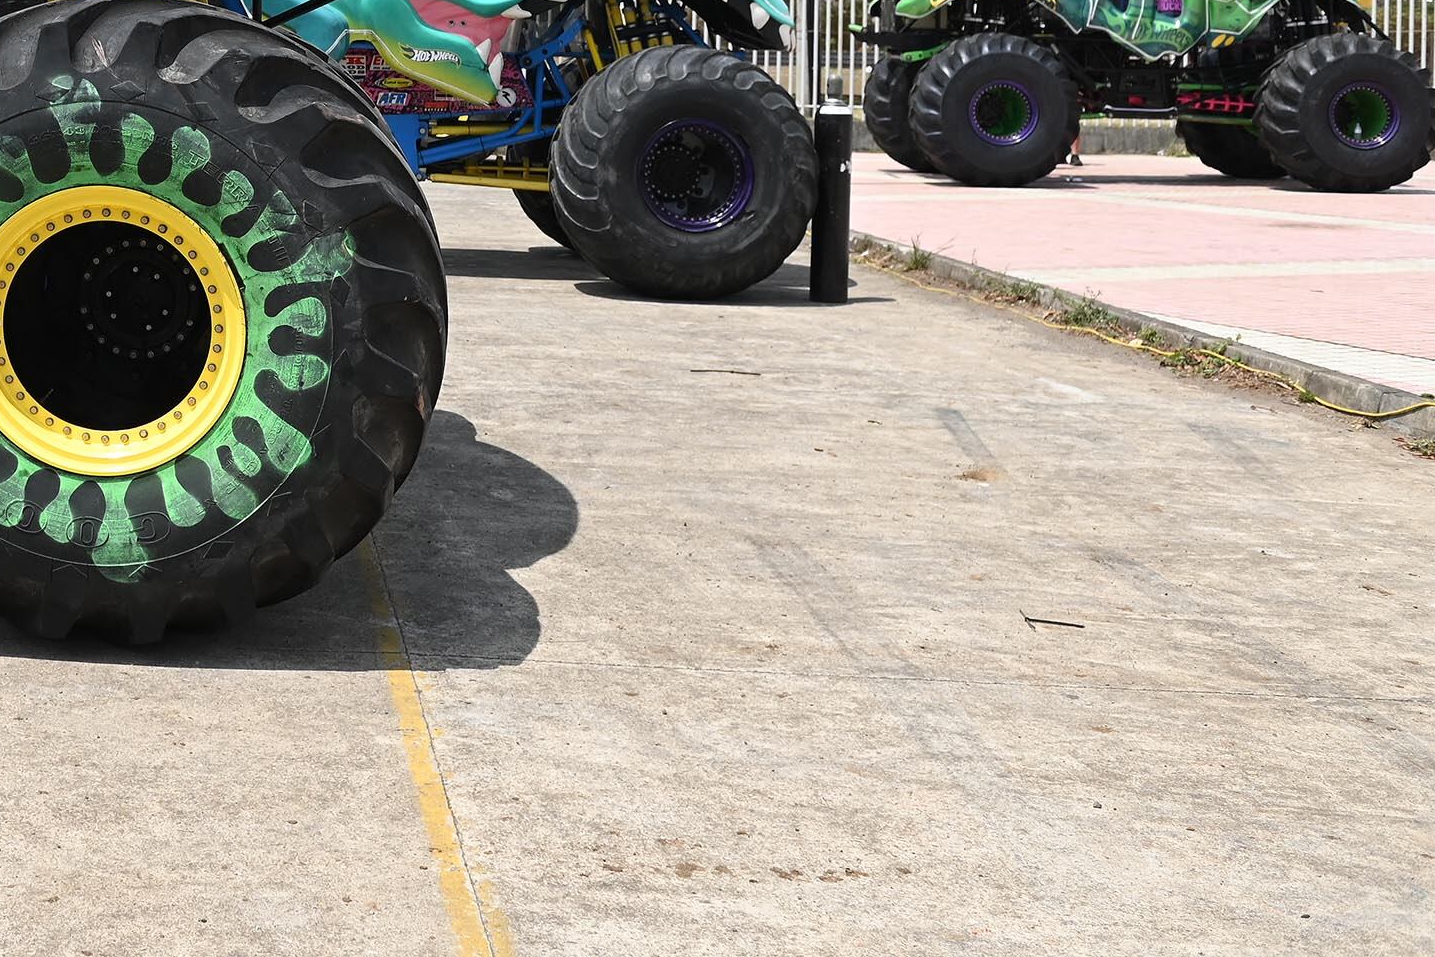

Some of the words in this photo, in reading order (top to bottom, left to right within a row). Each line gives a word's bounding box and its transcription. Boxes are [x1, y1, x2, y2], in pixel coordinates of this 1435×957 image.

[412, 49, 431, 62] HOT
[429, 50, 459, 62] WHEELS
[379, 93, 404, 104] AFR
